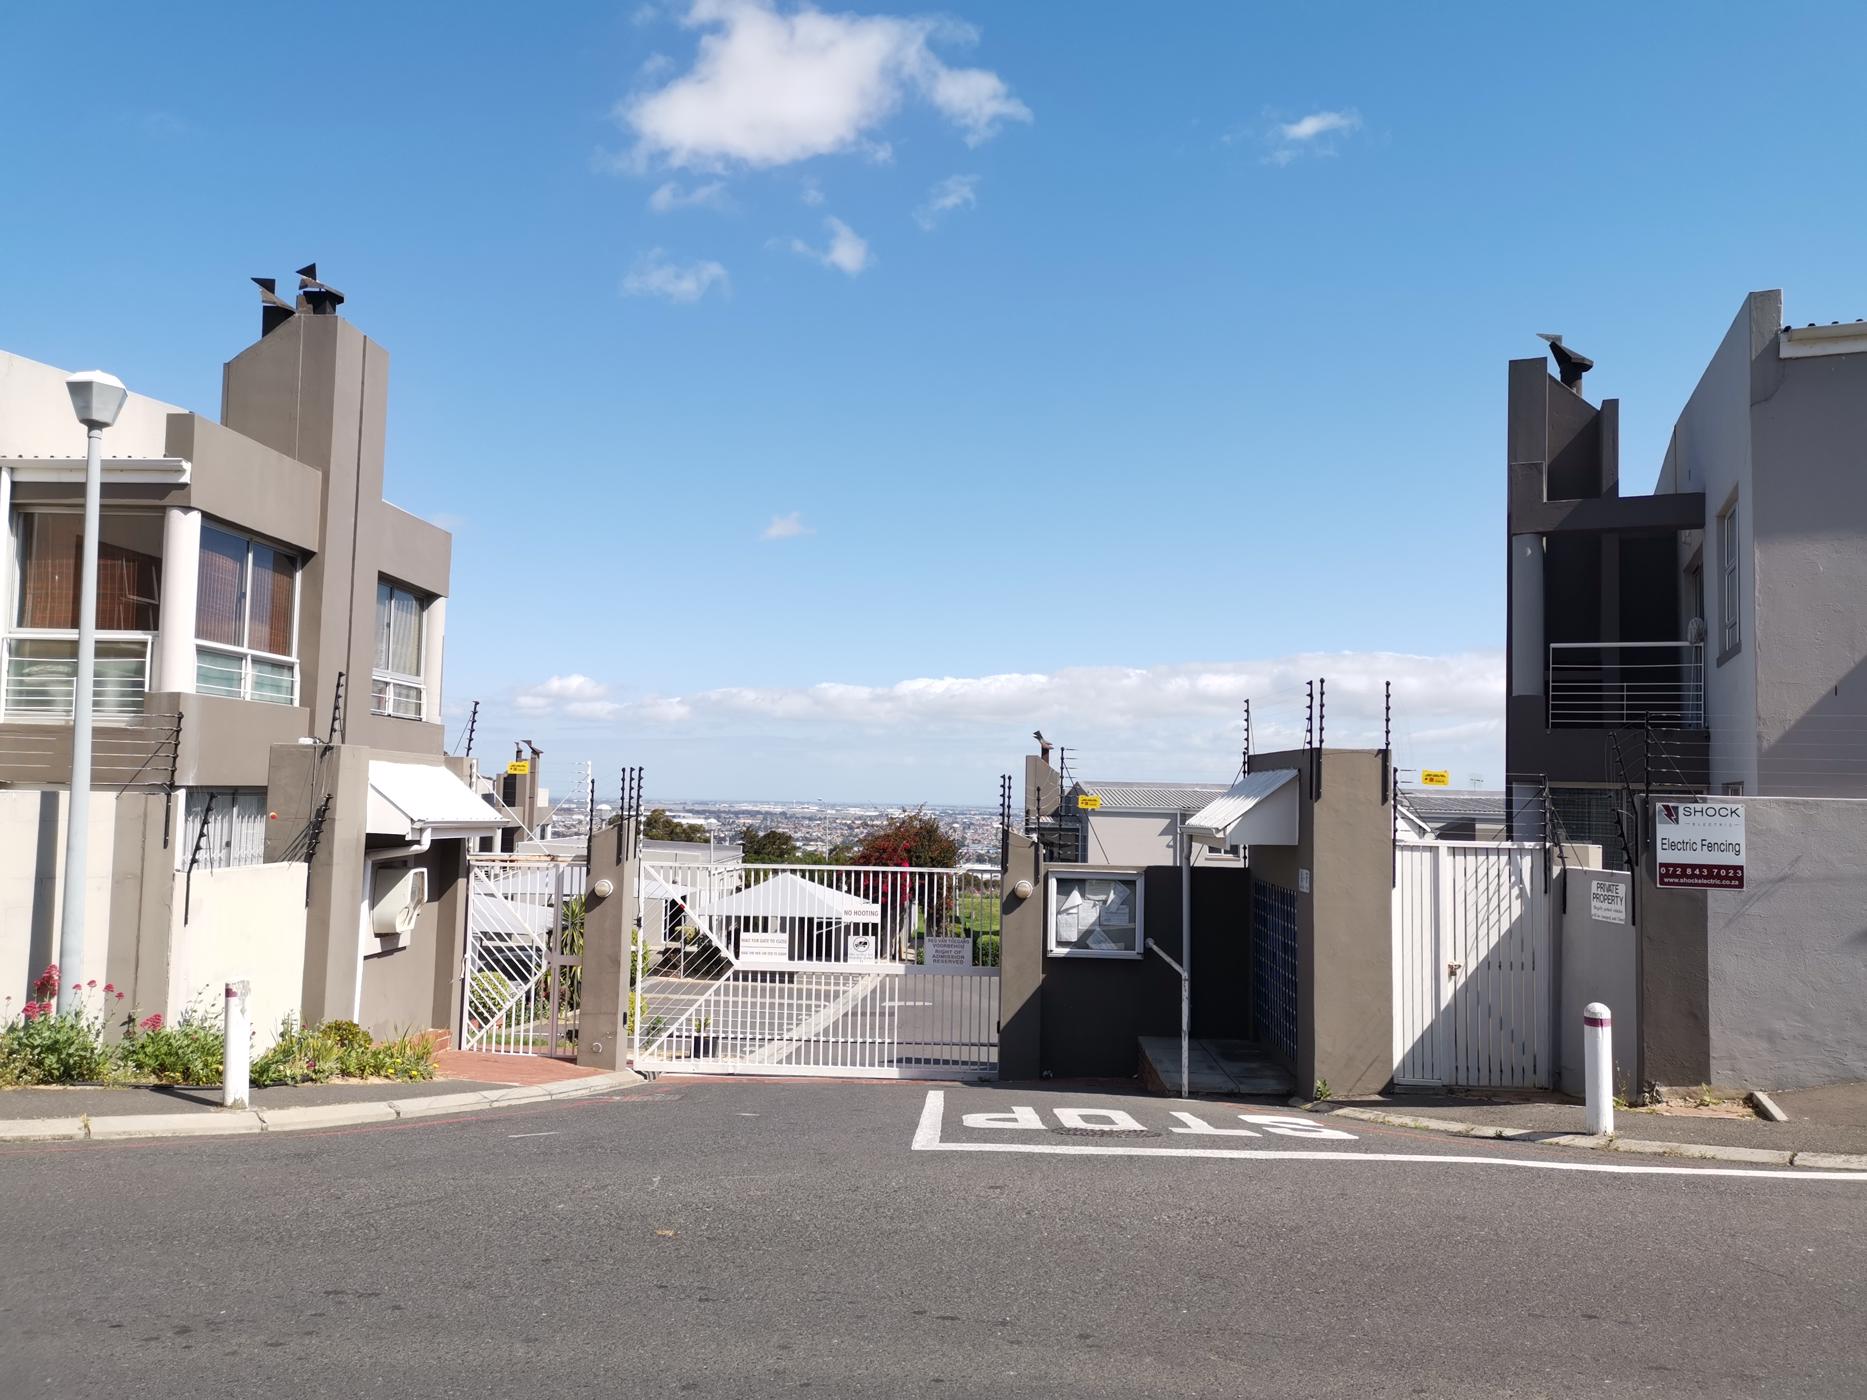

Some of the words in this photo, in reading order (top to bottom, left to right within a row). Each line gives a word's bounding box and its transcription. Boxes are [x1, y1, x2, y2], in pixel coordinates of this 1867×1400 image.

[1683, 806, 1741, 818] SHOCK
[1661, 838, 1698, 852] Electric
[1701, 839, 1741, 856] Fencing
[1660, 867, 1682, 875] 072
[1713, 869, 1742, 877] 7023
[1663, 877, 1739, 885] www.shockelectric.co.za
[1596, 882, 1620, 895] PRIVATE
[1592, 893, 1624, 906] PROPERTY
[962, 1106, 1358, 1140] STOP
